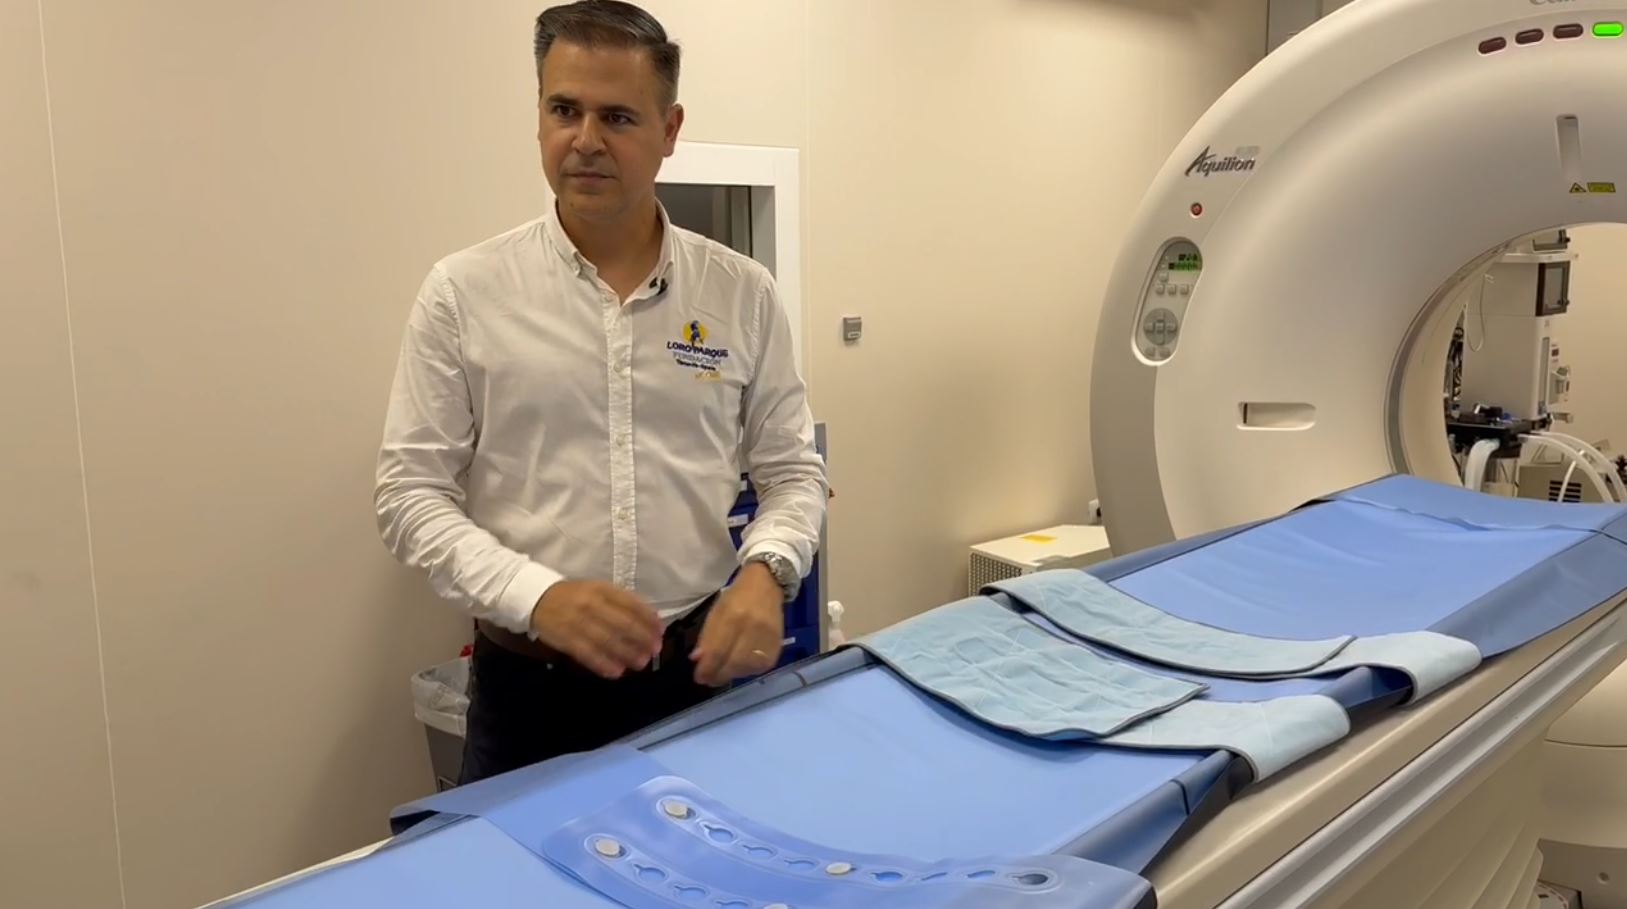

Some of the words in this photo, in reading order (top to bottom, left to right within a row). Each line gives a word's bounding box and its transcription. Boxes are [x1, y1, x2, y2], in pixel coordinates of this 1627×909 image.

[1185, 145, 1256, 177] Aquilion
[667, 341, 693, 353] LORO
[692, 346, 729, 358] PARQUE
